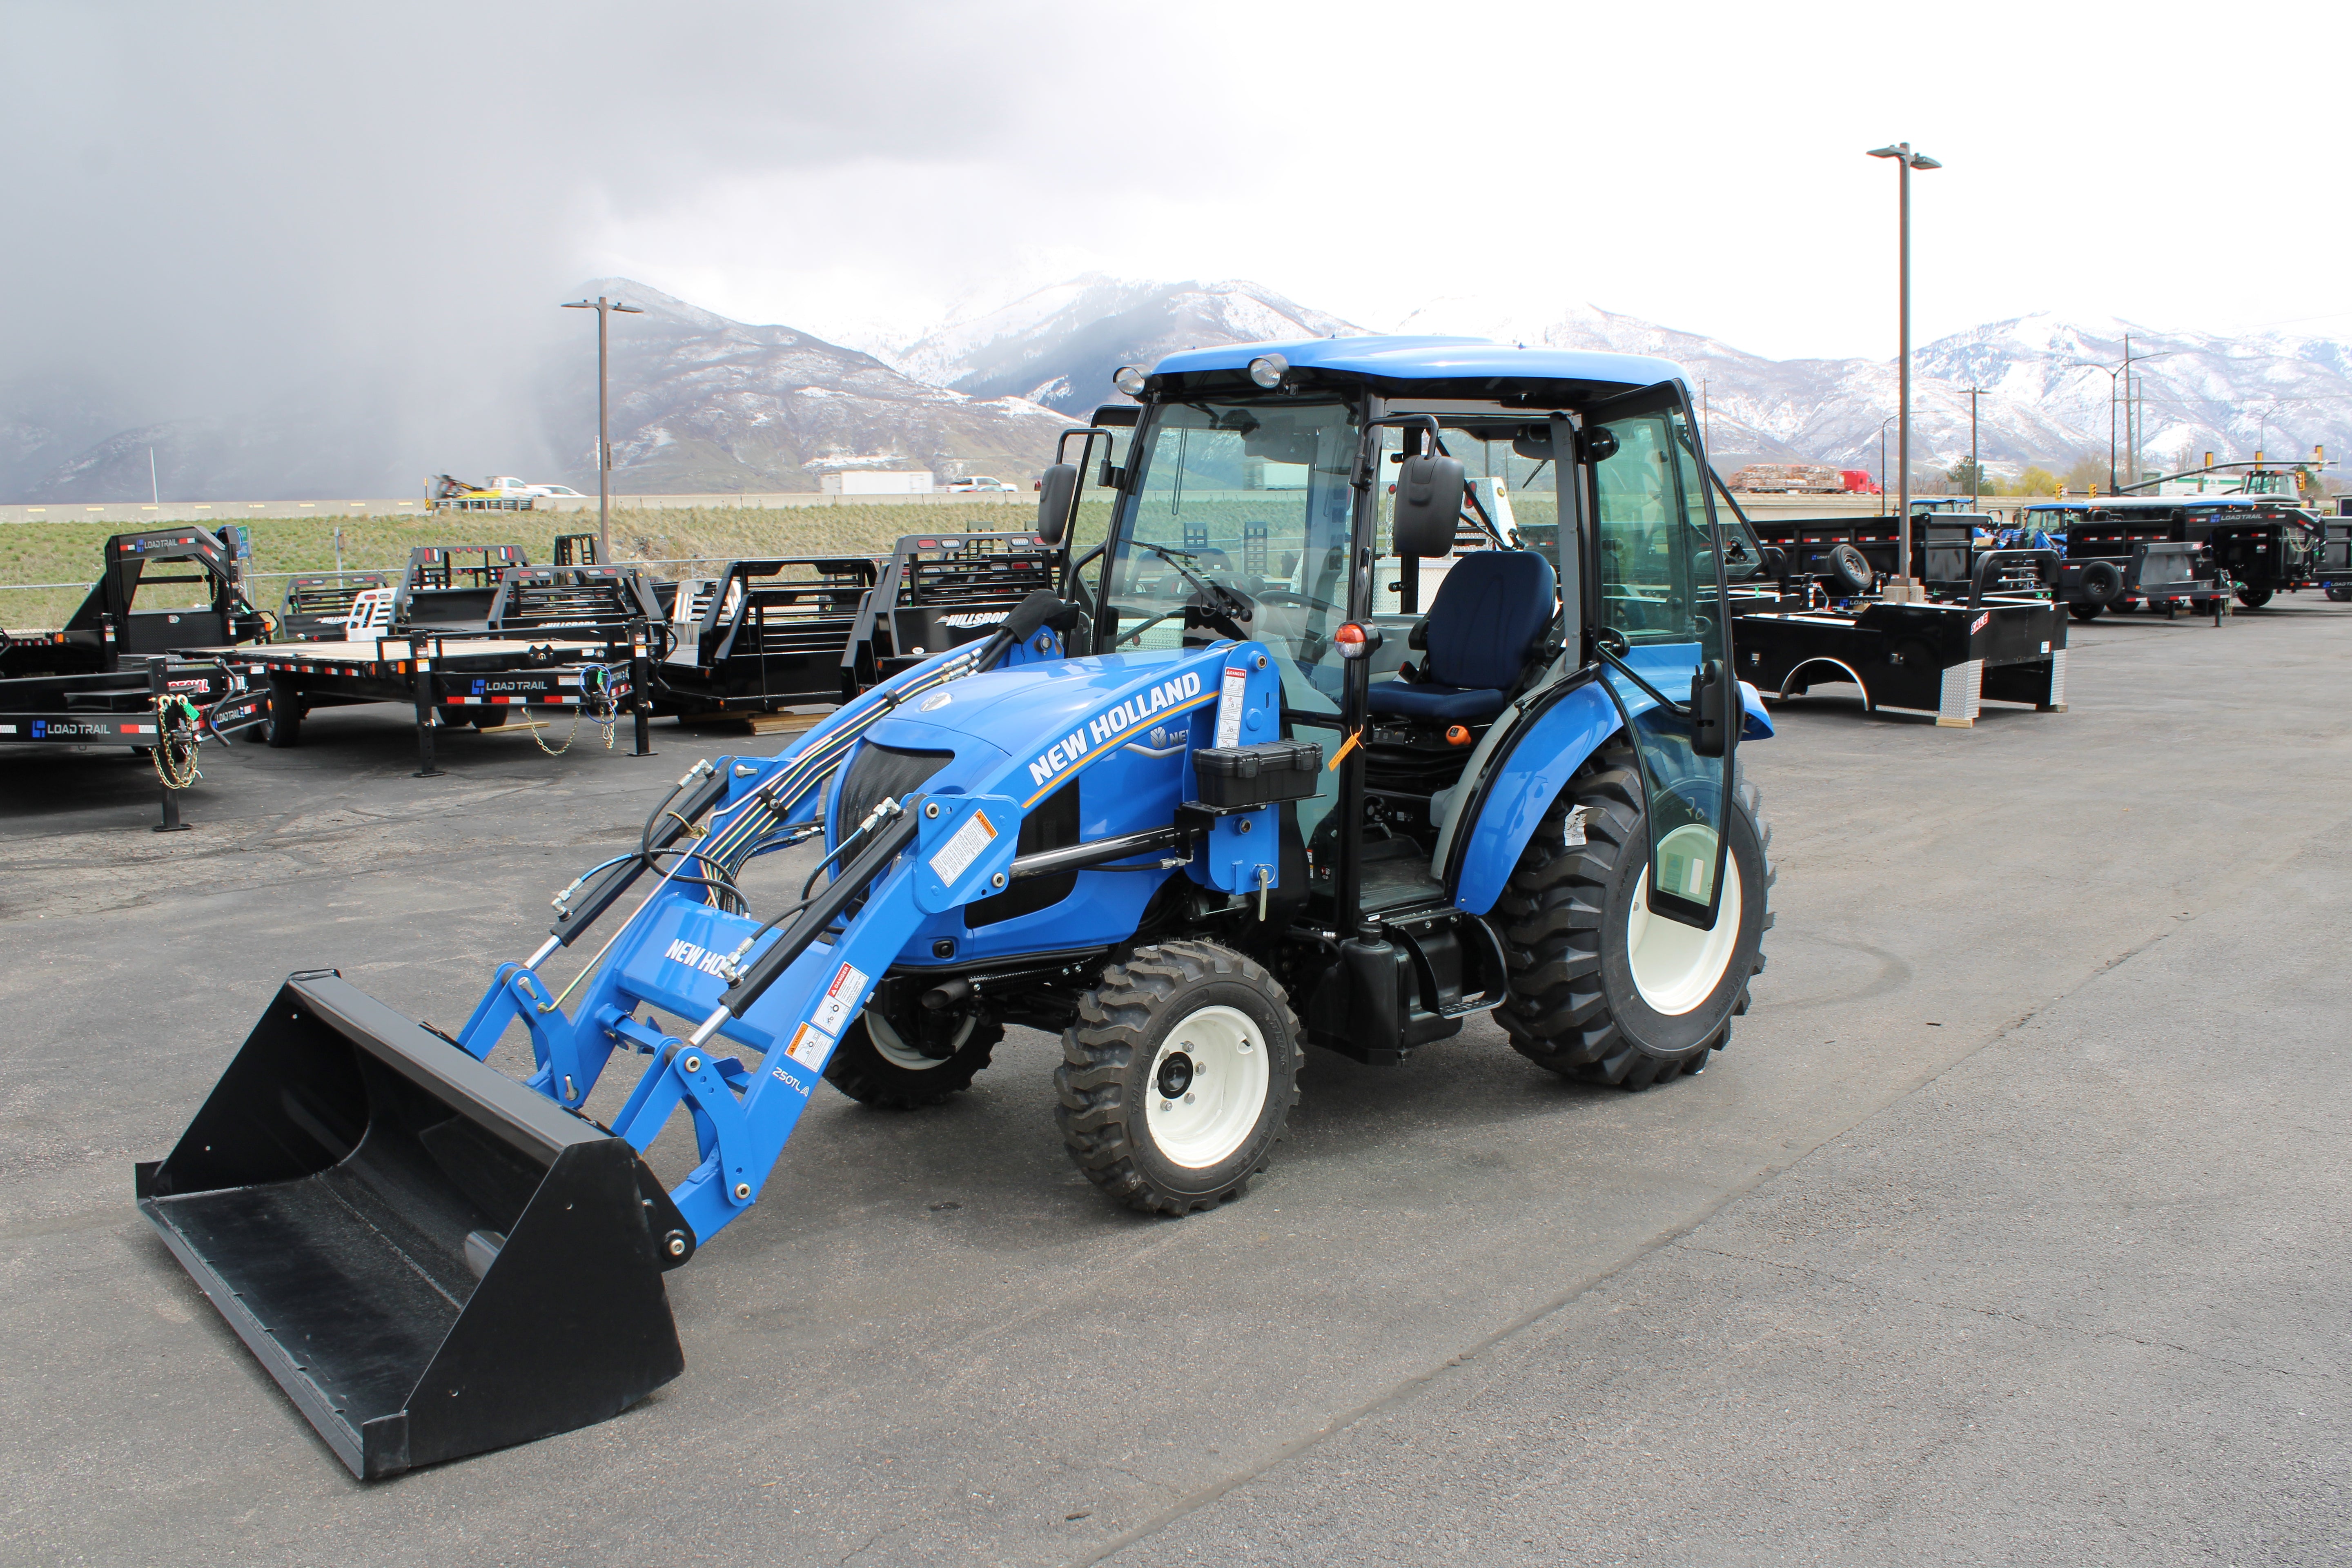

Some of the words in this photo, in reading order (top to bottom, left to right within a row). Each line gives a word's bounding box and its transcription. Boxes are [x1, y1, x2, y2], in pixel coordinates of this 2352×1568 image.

[144, 540, 160, 549] LOAD
[161, 539, 178, 547] TRAIL
[1970, 611, 1990, 635] SALE
[486, 682, 515, 691] LOAD
[517, 681, 548, 690] TRAIL
[217, 711, 229, 724] LOAD
[47, 724, 78, 734] LOAD
[78, 724, 111, 734] TRAIL
[1028, 728, 1089, 786] NEW
[1089, 672, 1201, 745] HOLLAND
[981, 819, 993, 836] WARNING
[664, 938, 706, 967] NEW
[834, 966, 849, 989] DANGER
[793, 1027, 805, 1047] WARNING
[772, 1066, 810, 1097] 250TLA
